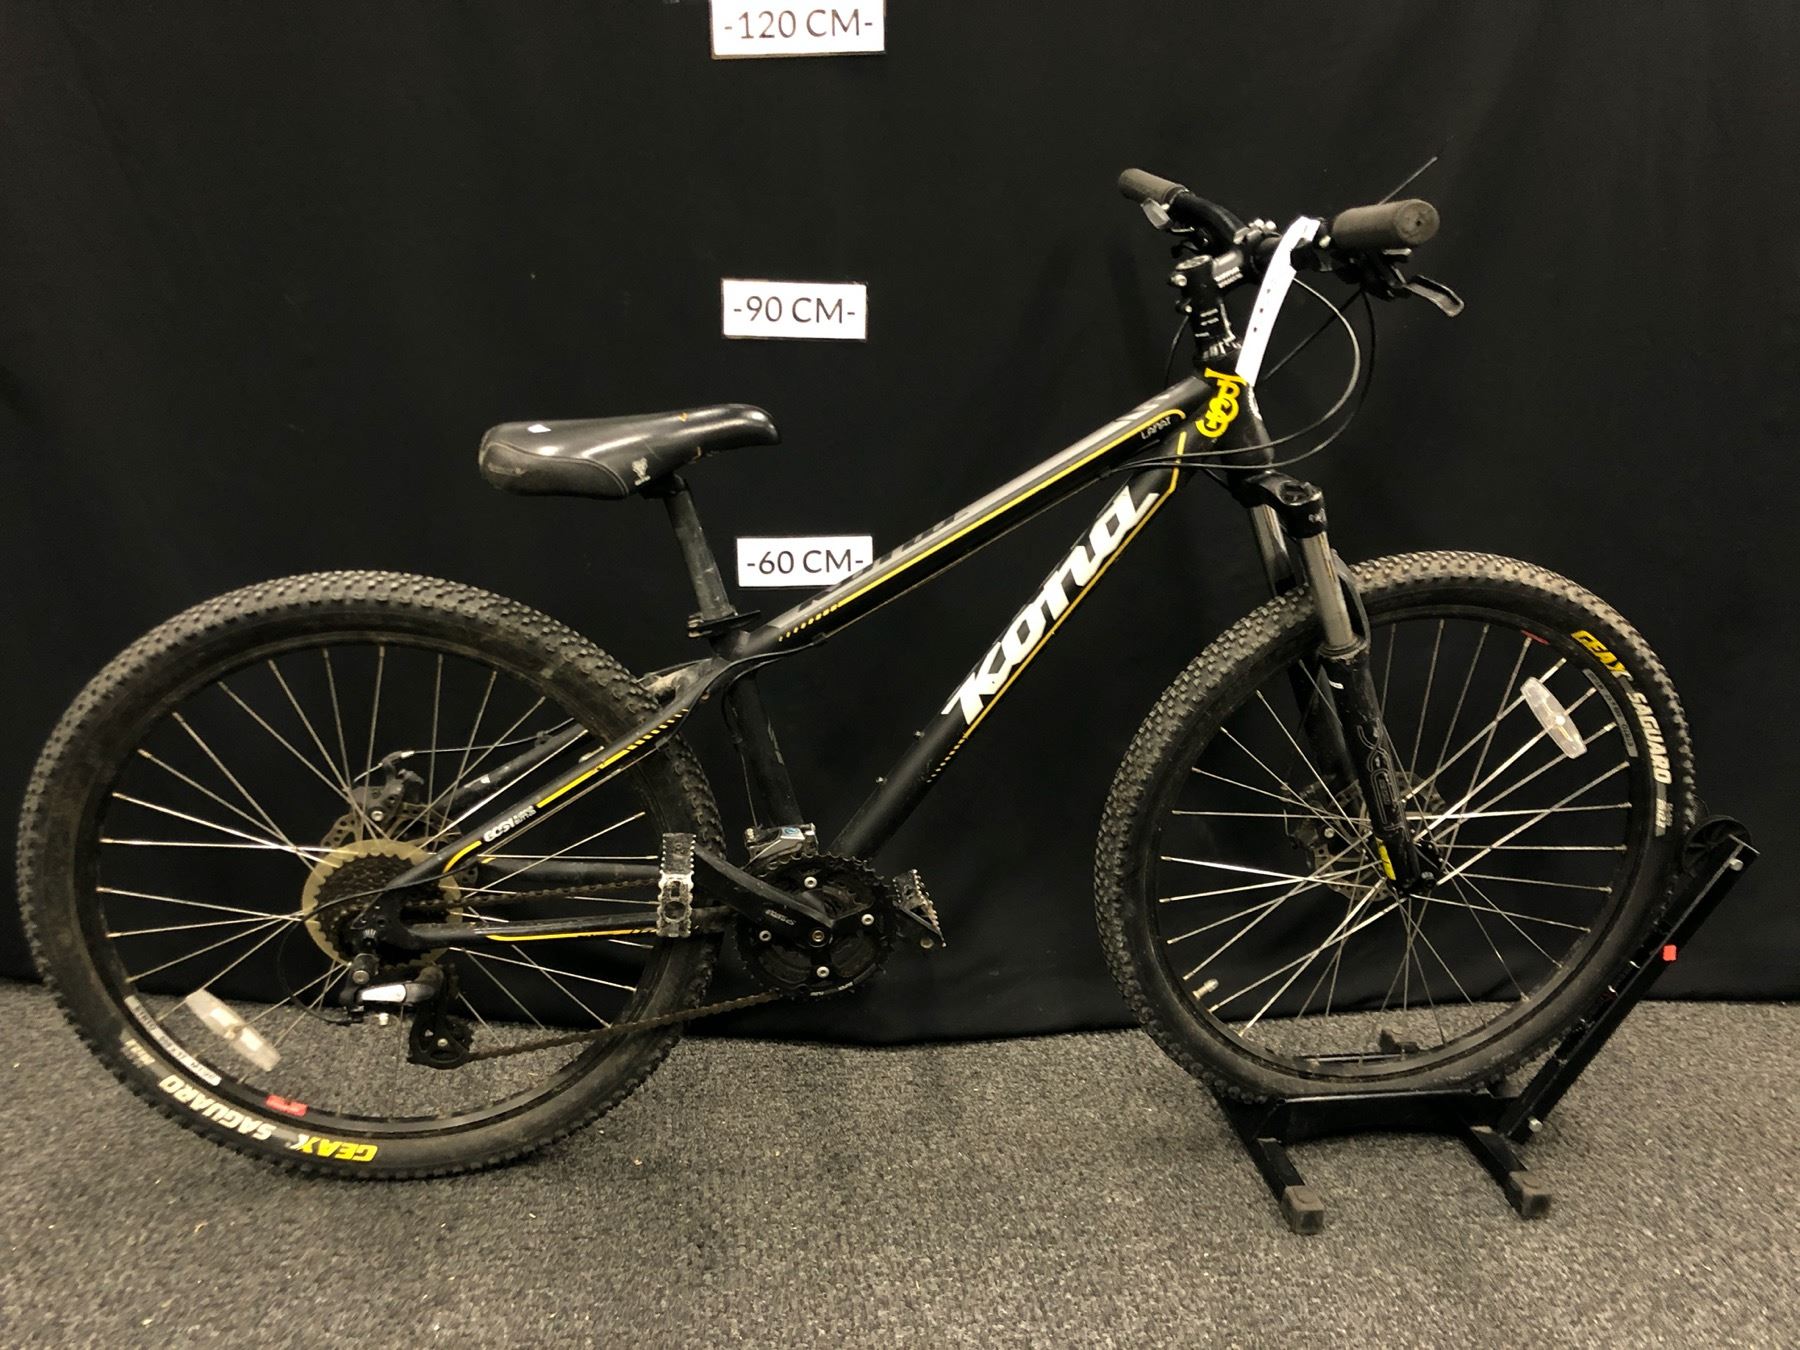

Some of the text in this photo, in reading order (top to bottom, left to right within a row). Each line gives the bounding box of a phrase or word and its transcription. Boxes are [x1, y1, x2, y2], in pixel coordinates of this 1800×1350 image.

[724, 8, 873, 39] -120 CM-
[733, 295, 856, 324] -90 CM-
[746, 549, 864, 575] -60 CM-
[1626, 691, 1673, 785] SAGUARO
[157, 1073, 277, 1142] SAGUARO
